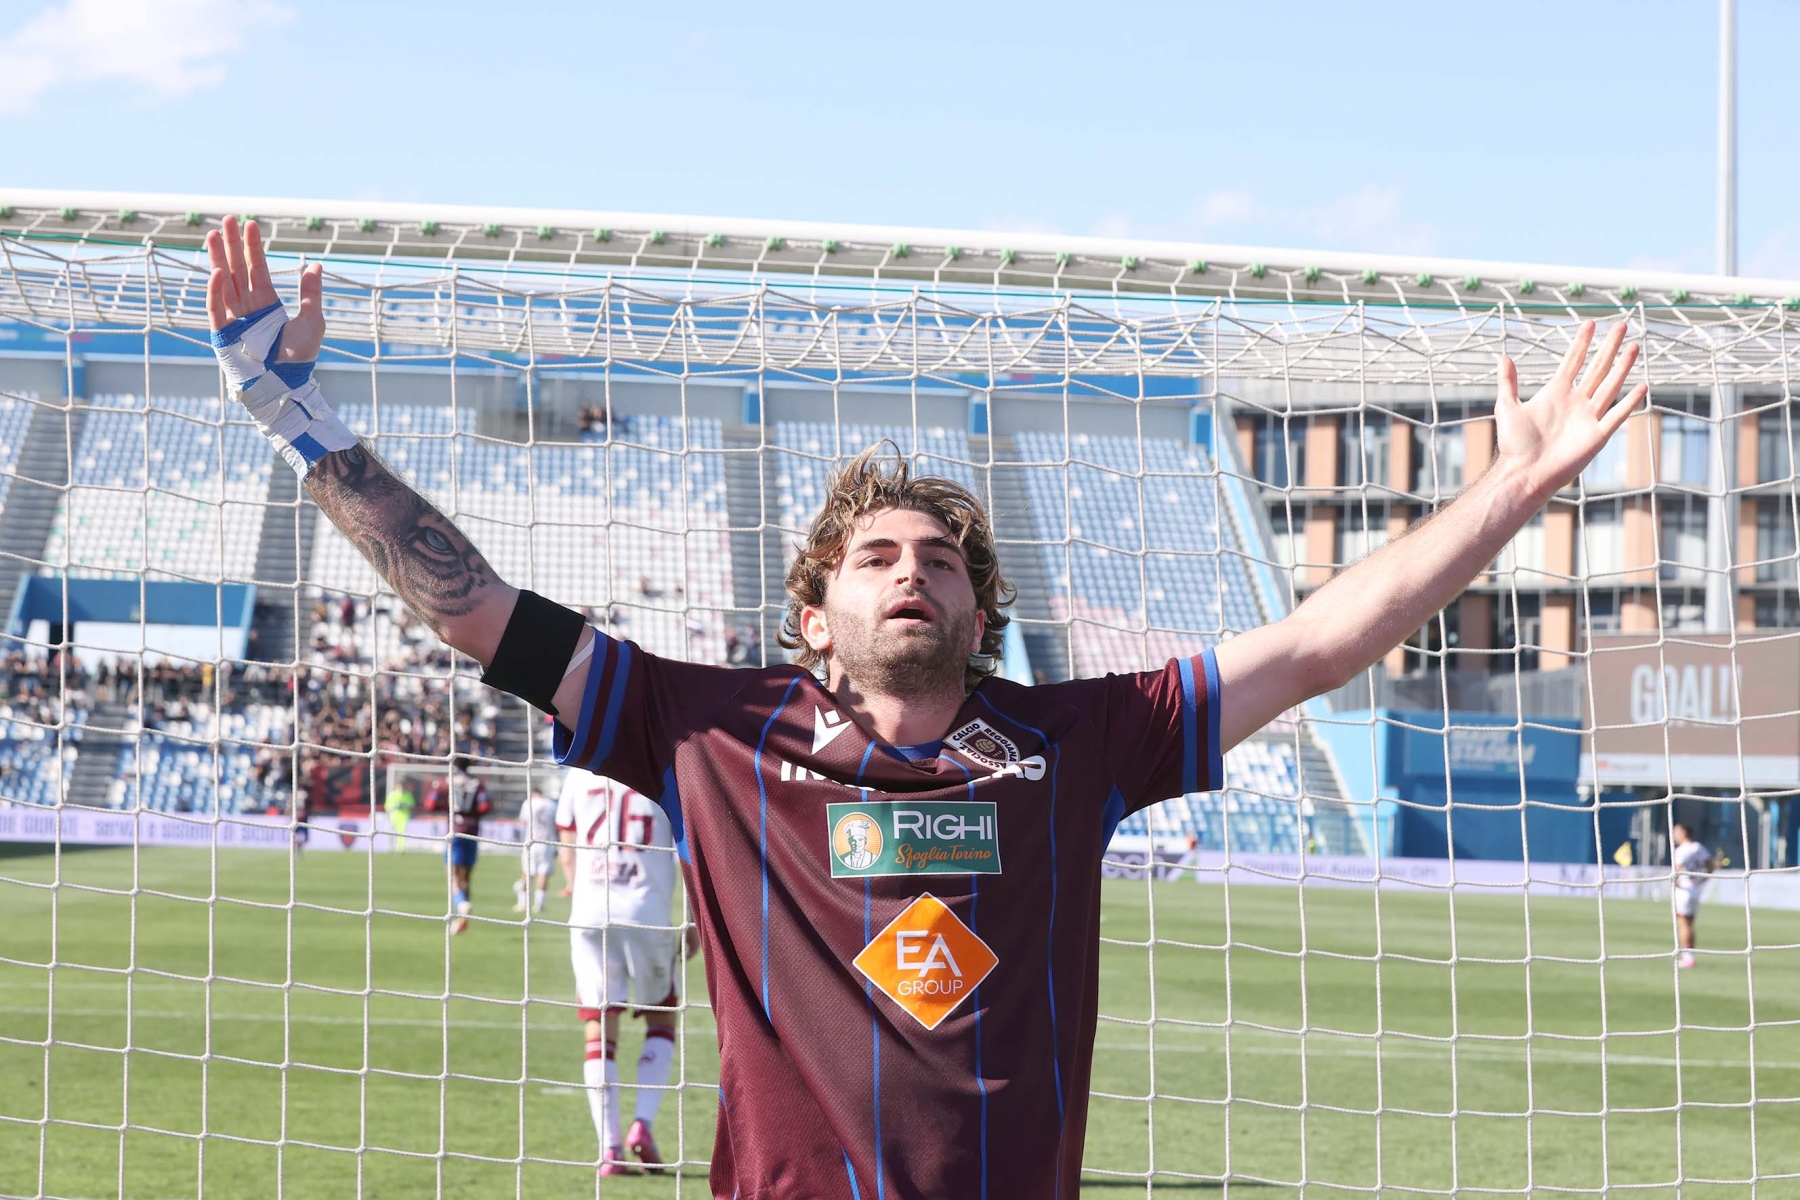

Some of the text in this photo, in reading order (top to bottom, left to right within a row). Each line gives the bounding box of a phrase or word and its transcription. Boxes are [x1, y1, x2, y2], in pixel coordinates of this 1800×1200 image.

[952, 723, 981, 741] CALCIO
[984, 728, 1017, 762] REGGIANA
[958, 742, 1007, 769] ASSOCIAZ.
[587, 788, 653, 853] 76
[892, 810, 993, 840] RIGHI
[895, 843, 993, 869] Sfoglia Torino
[896, 929, 963, 978] EA
[897, 979, 964, 996] GROUP
